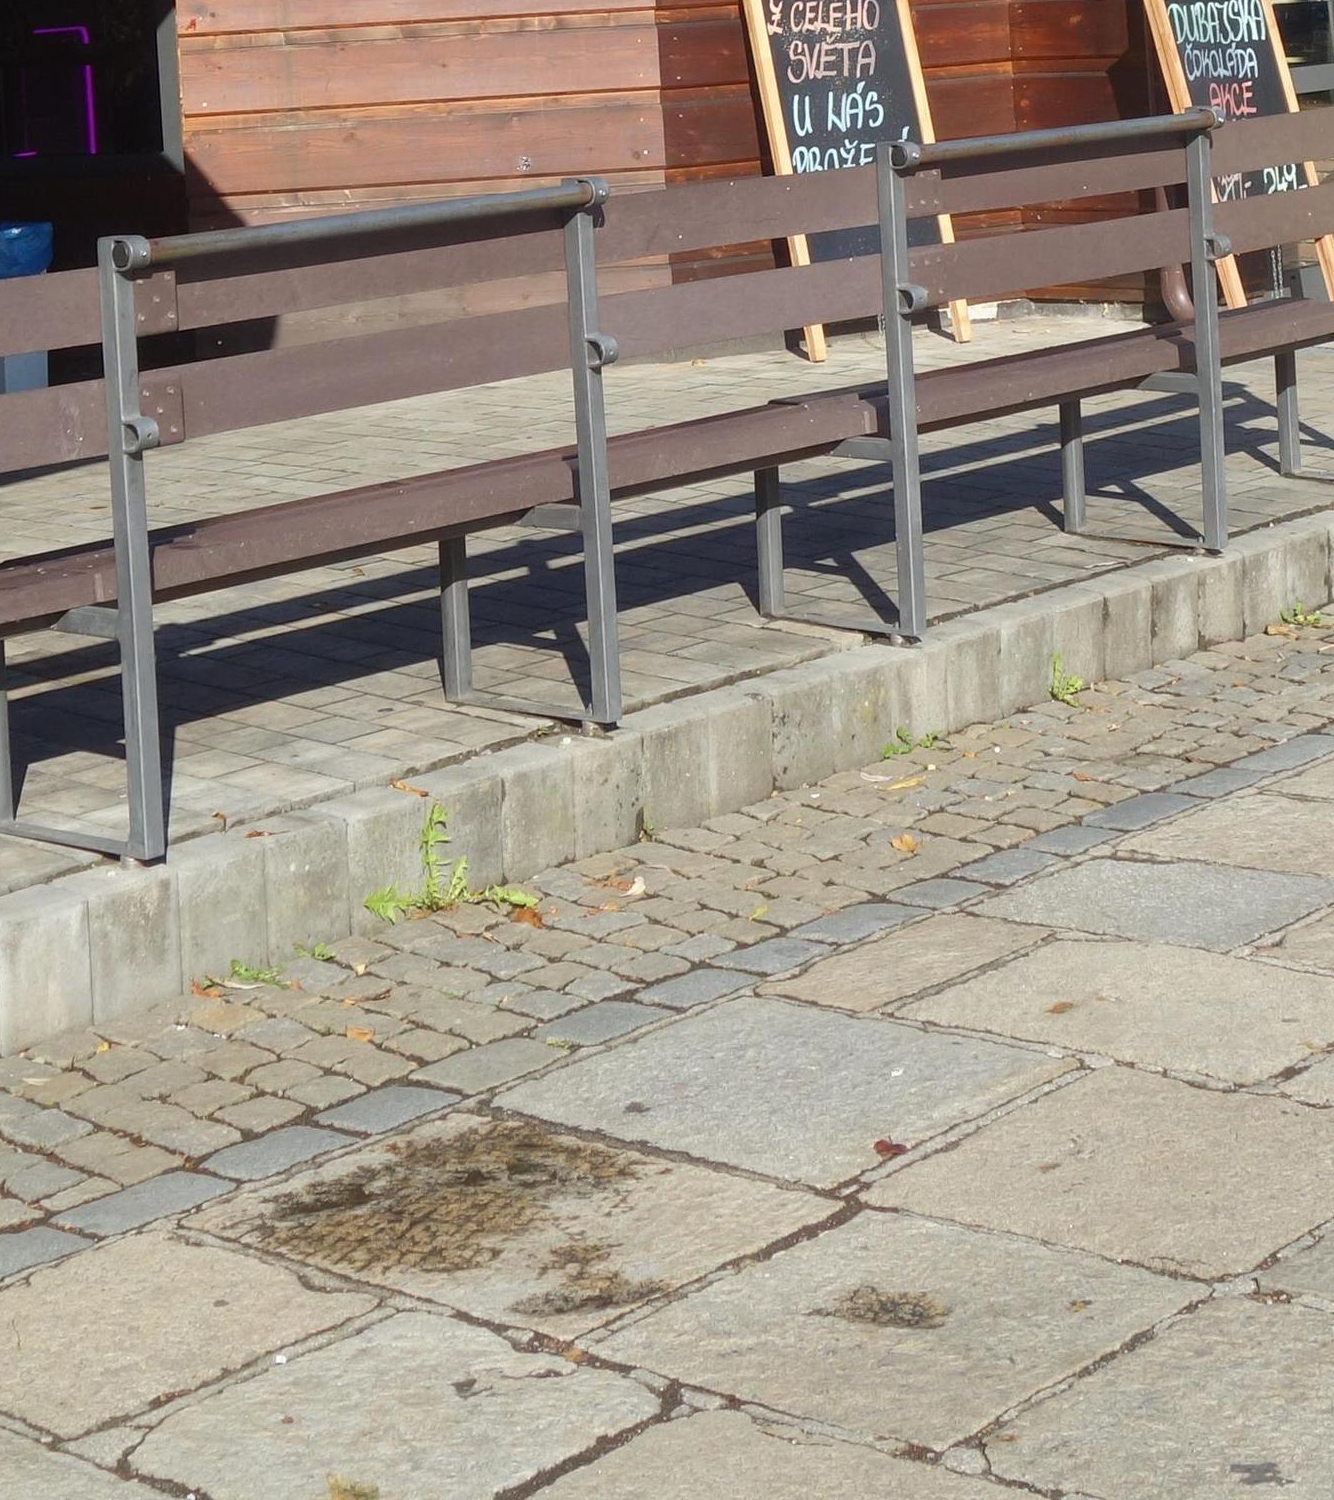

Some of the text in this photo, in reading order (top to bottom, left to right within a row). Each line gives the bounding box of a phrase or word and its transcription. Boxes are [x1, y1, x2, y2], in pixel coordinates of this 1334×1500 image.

[787, 32, 876, 84] SVĚTA
[1184, 42, 1259, 81] ČOKOLÁDA
[792, 80, 884, 137] U NÁS
[1209, 81, 1257, 116] AKCE
